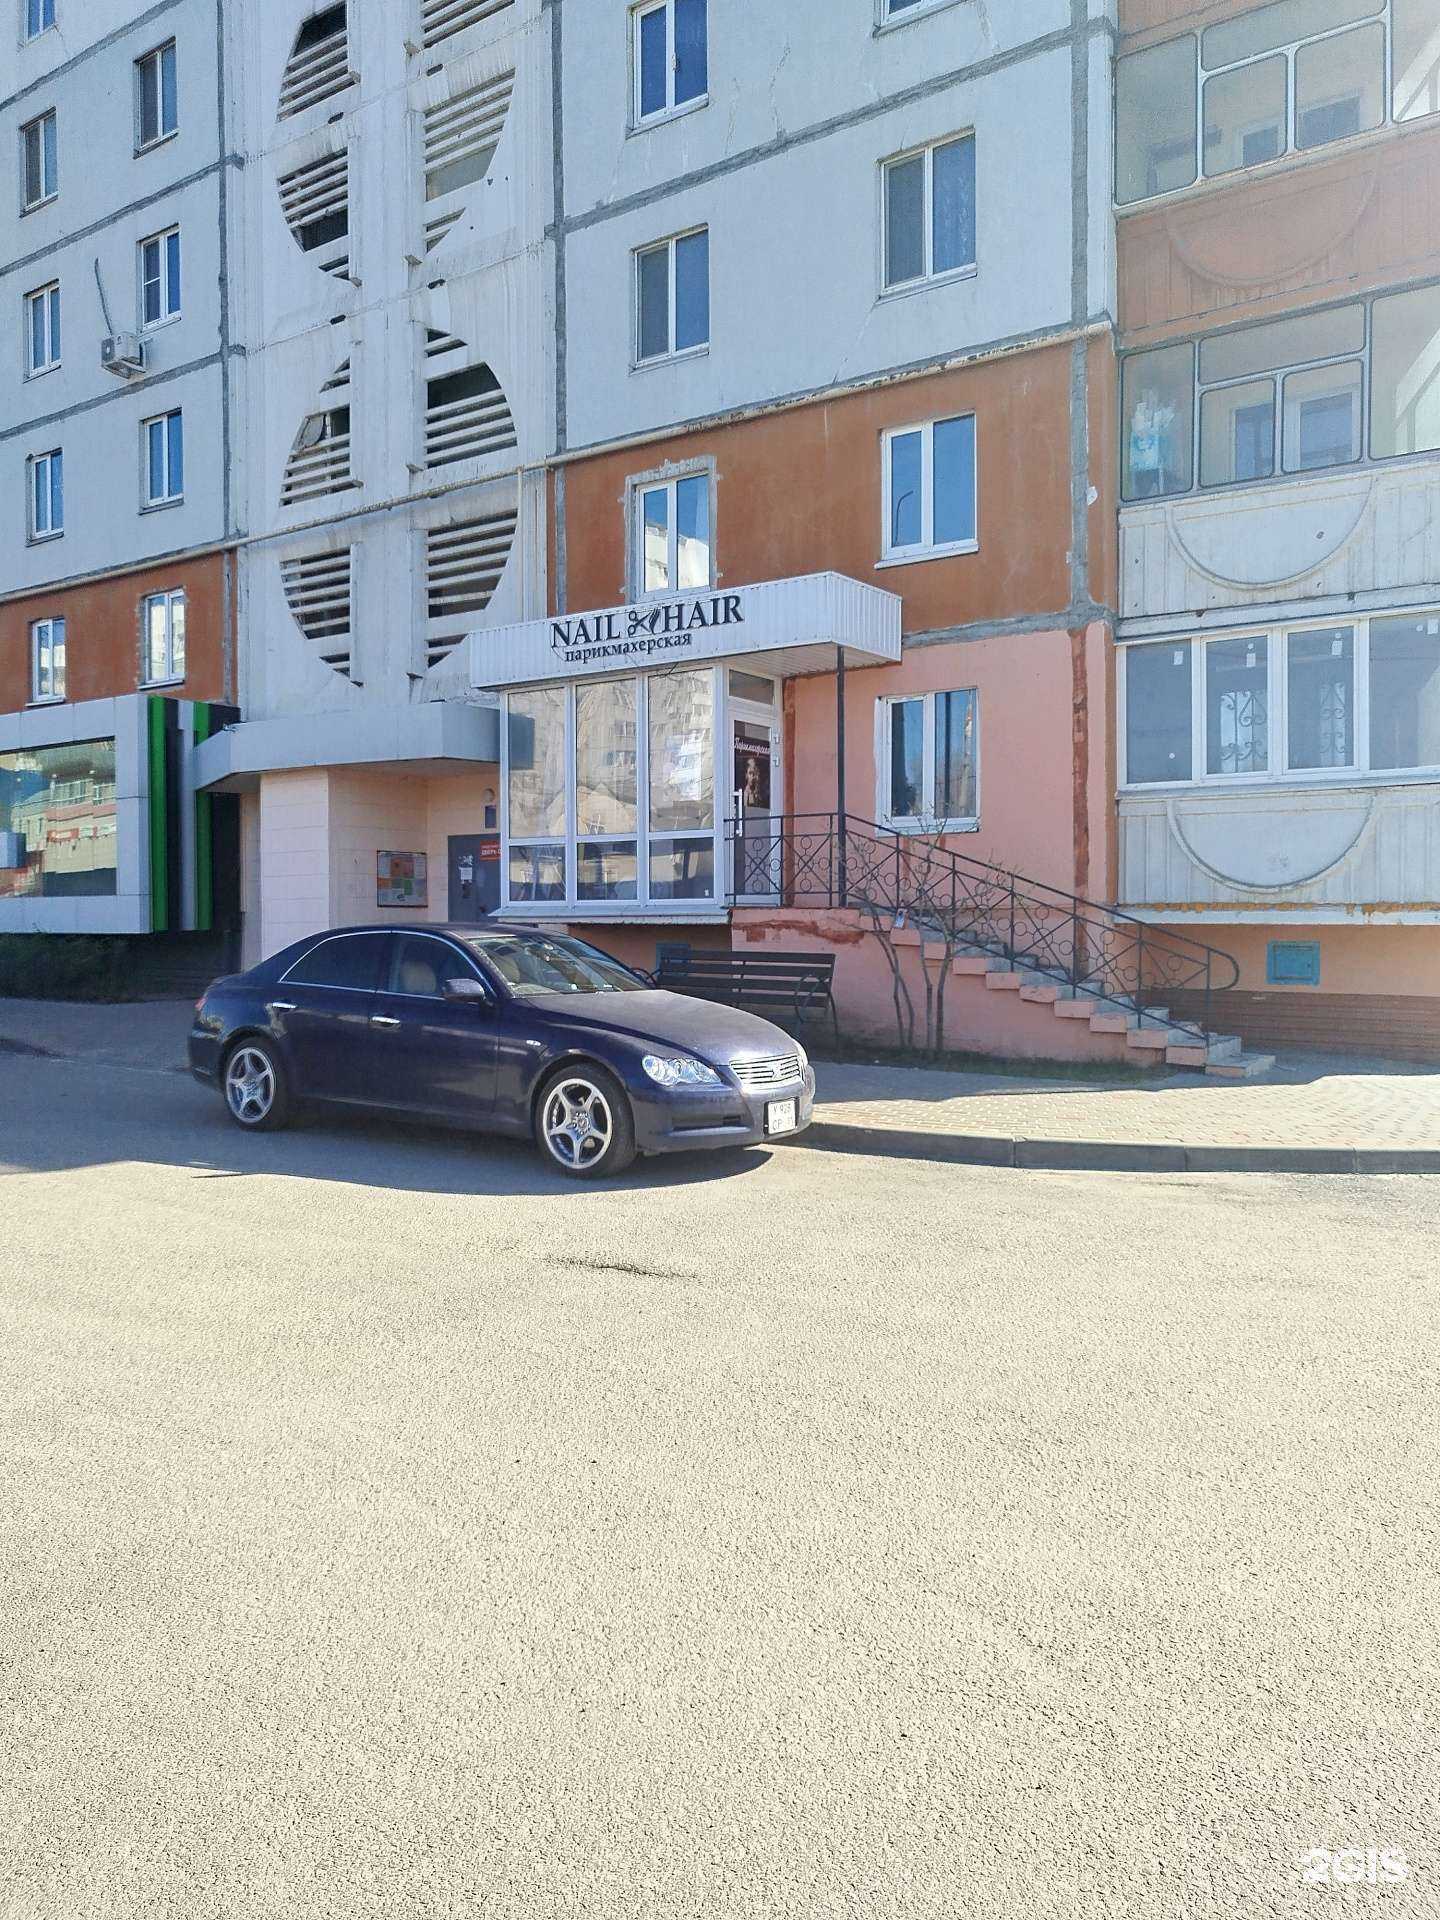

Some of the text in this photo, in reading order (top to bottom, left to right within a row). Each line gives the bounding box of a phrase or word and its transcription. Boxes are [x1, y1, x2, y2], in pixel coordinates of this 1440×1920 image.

[551, 595, 744, 648] NAIL HAIR
[564, 633, 692, 664] парикмахерская
